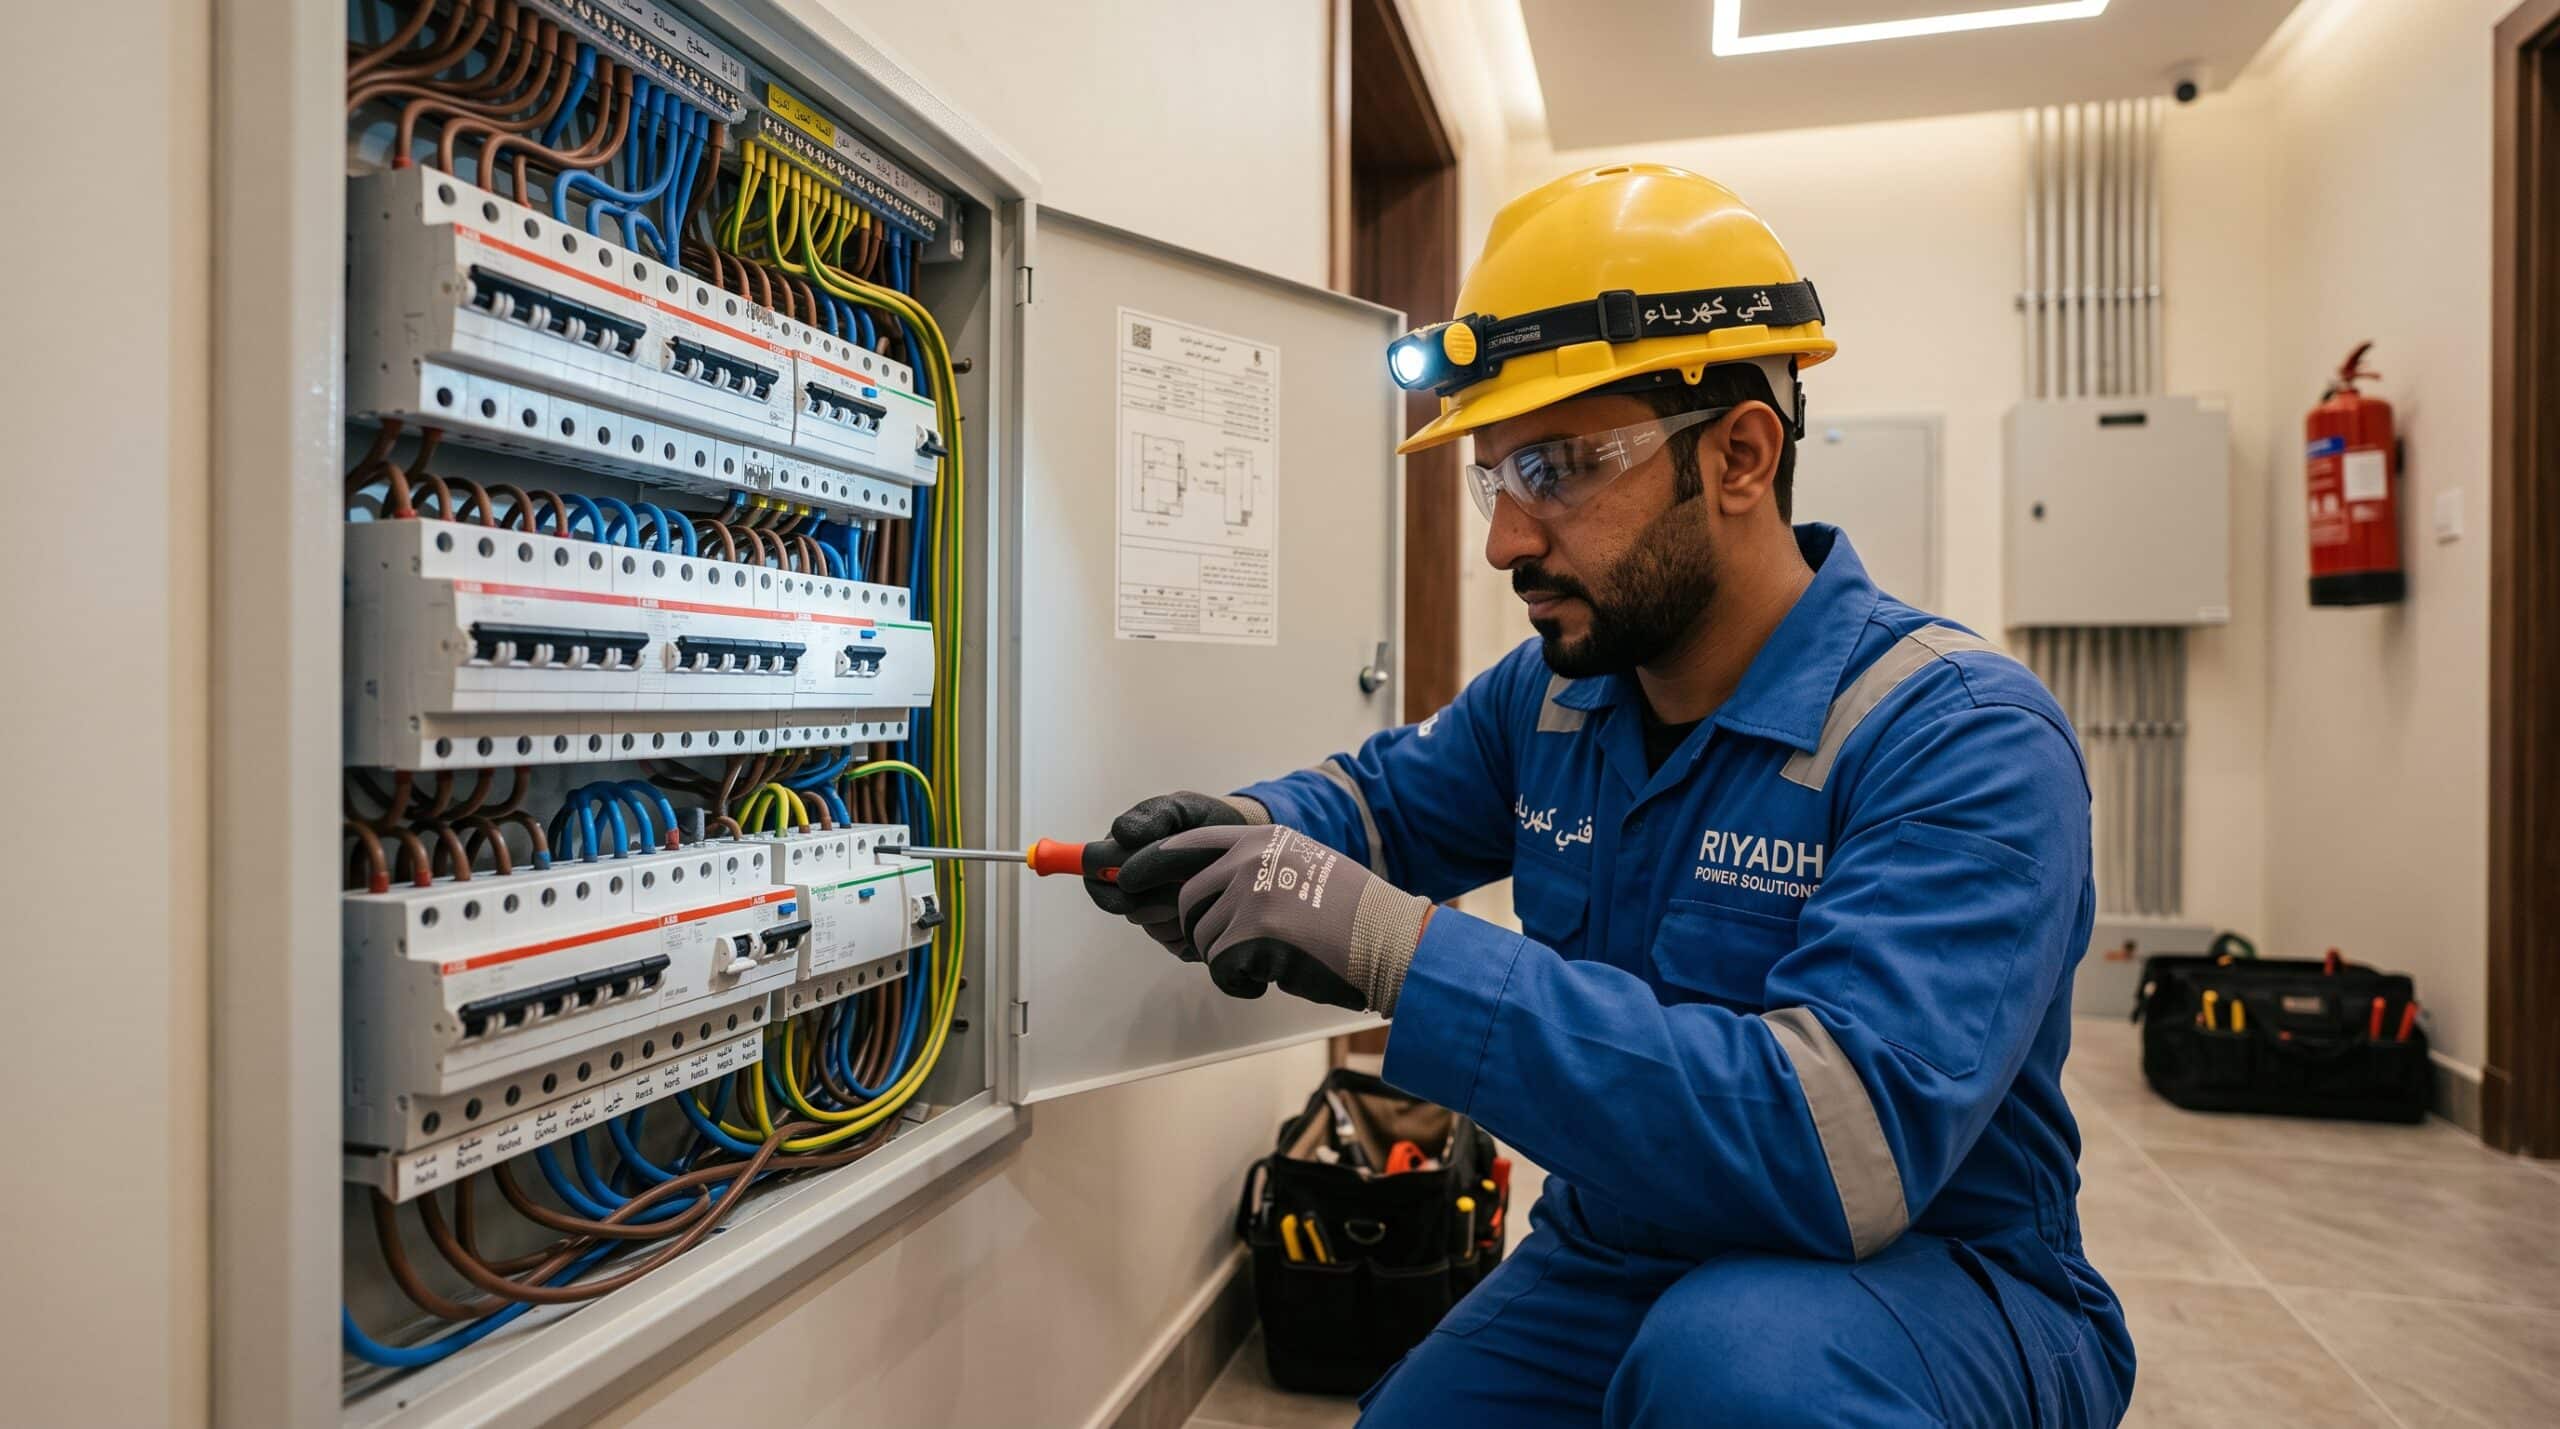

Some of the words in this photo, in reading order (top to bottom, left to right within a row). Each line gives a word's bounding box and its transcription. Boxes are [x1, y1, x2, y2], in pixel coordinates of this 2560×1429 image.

[1644, 295, 1728, 325] كهرباء
[1736, 290, 1773, 323] فني
[1554, 815, 1593, 852] فني
[1698, 829, 1824, 878] RIYADH
[1694, 866, 1738, 886] POWER
